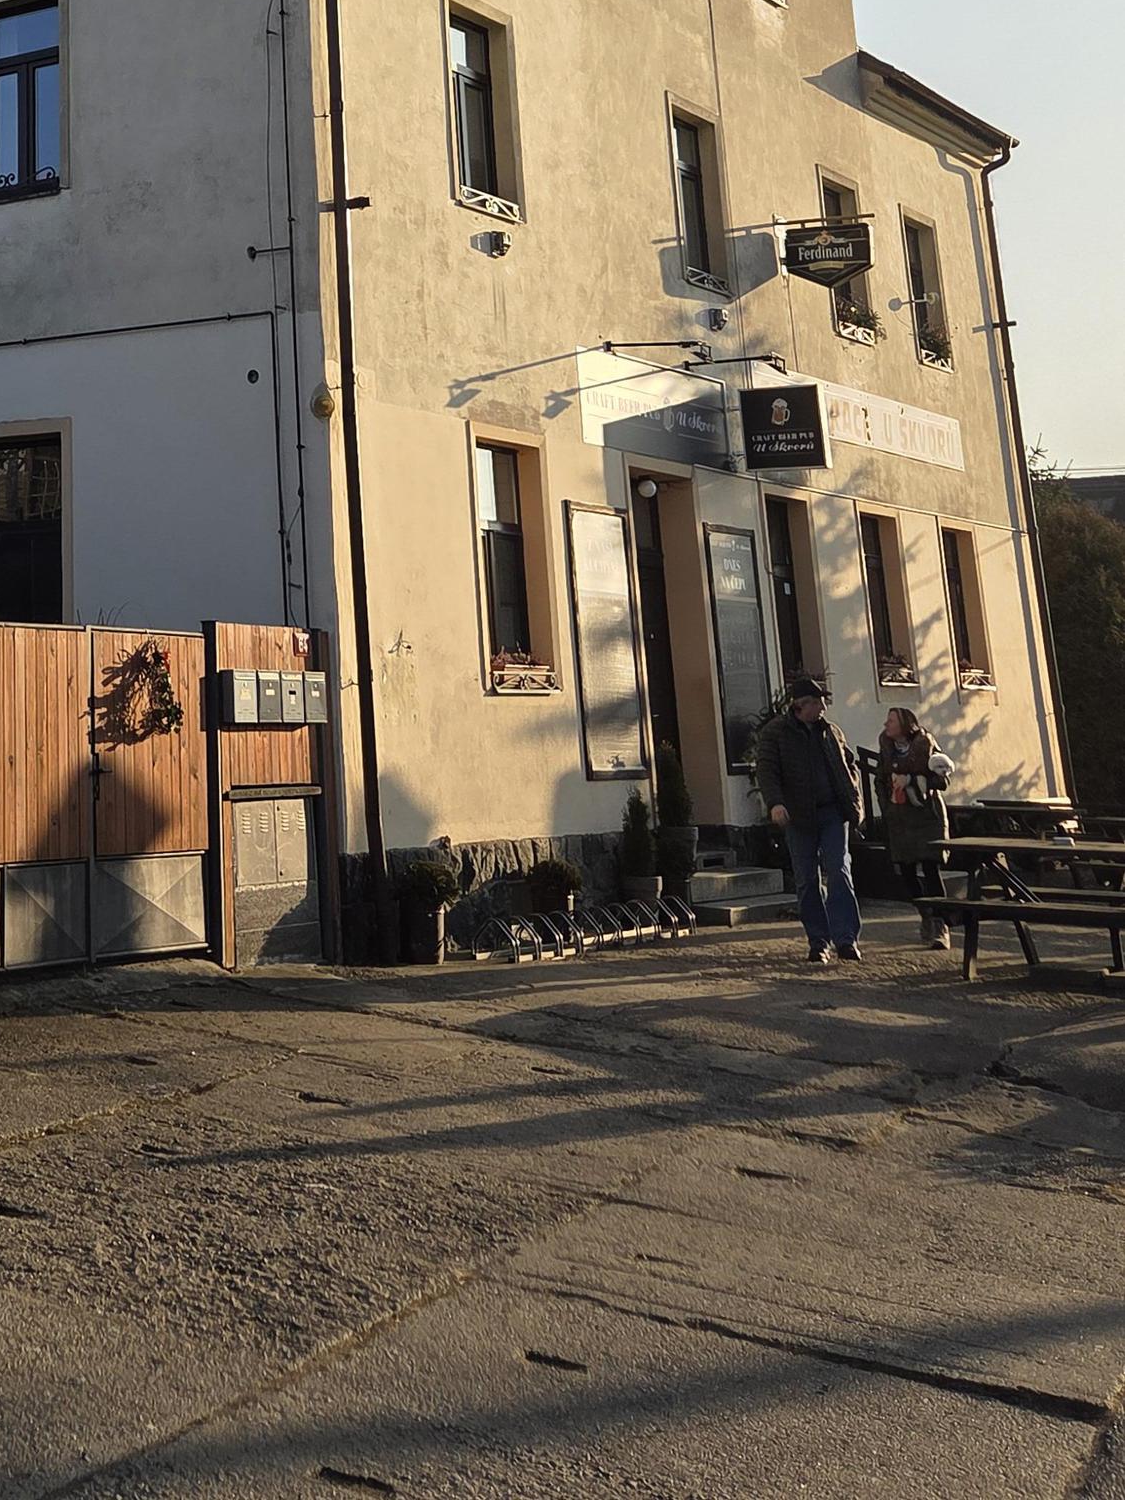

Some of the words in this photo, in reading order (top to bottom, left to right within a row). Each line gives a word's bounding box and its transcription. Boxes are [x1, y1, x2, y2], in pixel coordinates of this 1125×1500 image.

[798, 243, 853, 261] Ferdinand
[882, 412, 893, 445] U
[753, 443, 766, 452] U
